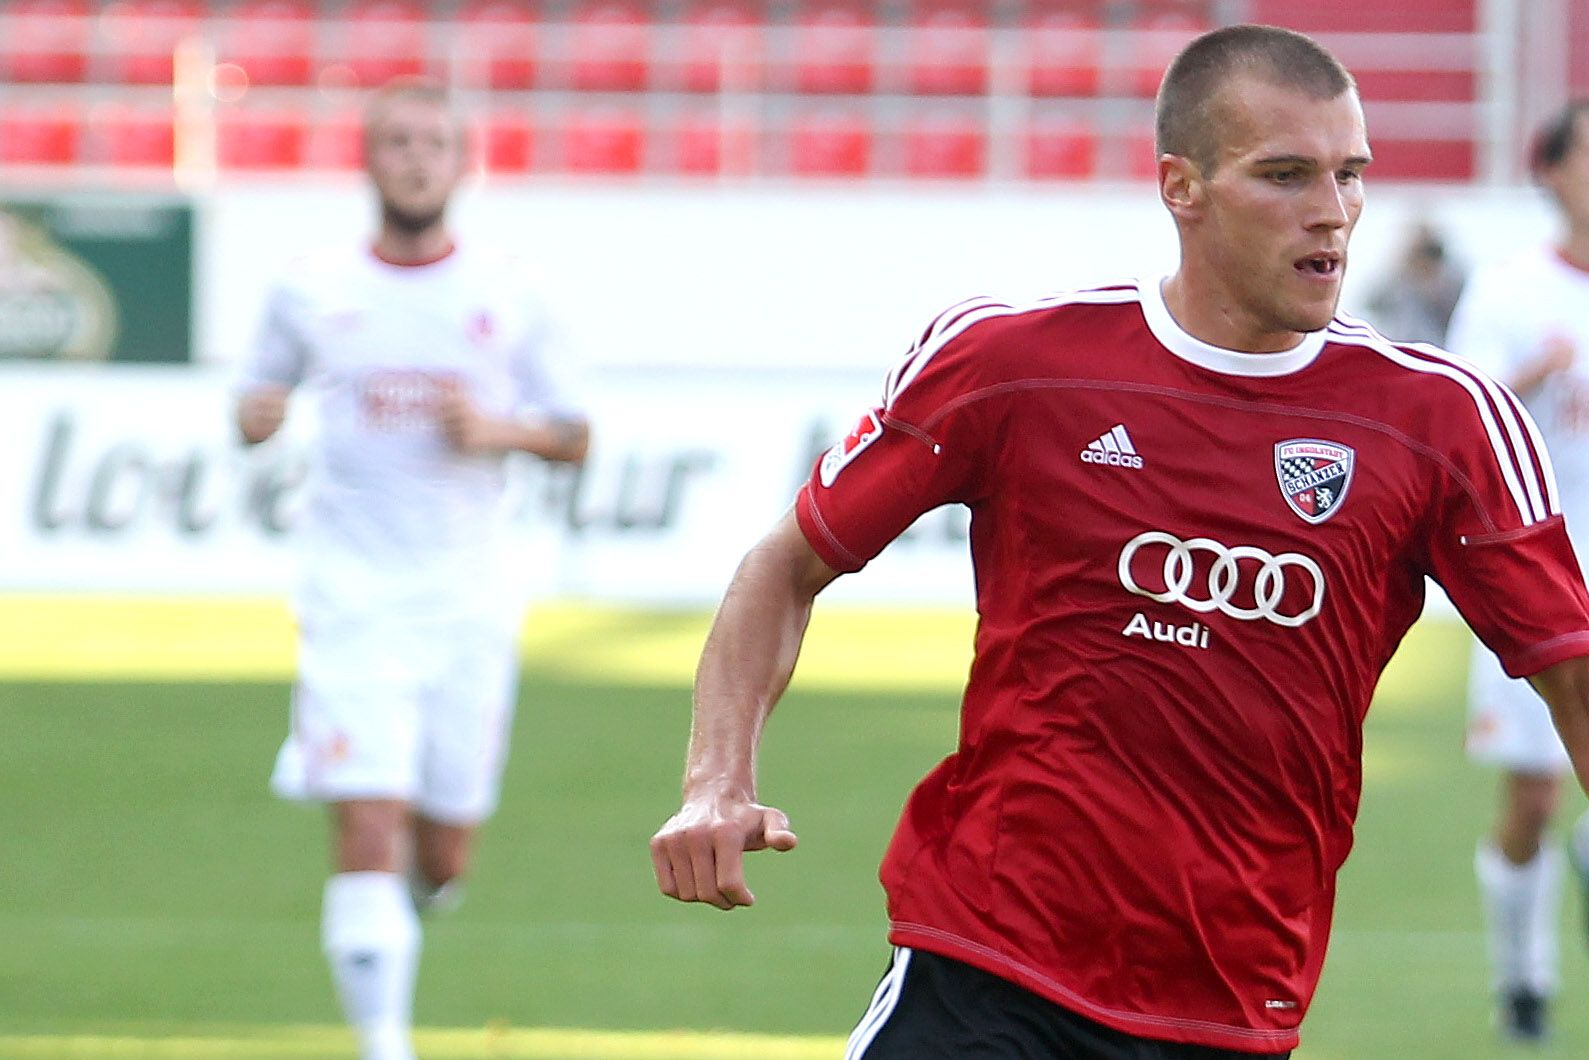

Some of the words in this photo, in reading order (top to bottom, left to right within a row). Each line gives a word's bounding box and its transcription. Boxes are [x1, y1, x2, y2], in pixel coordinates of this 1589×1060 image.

[1080, 450, 1145, 470] adidas
[1287, 462, 1345, 493] SCHANZER
[1122, 612, 1210, 649] Audi
